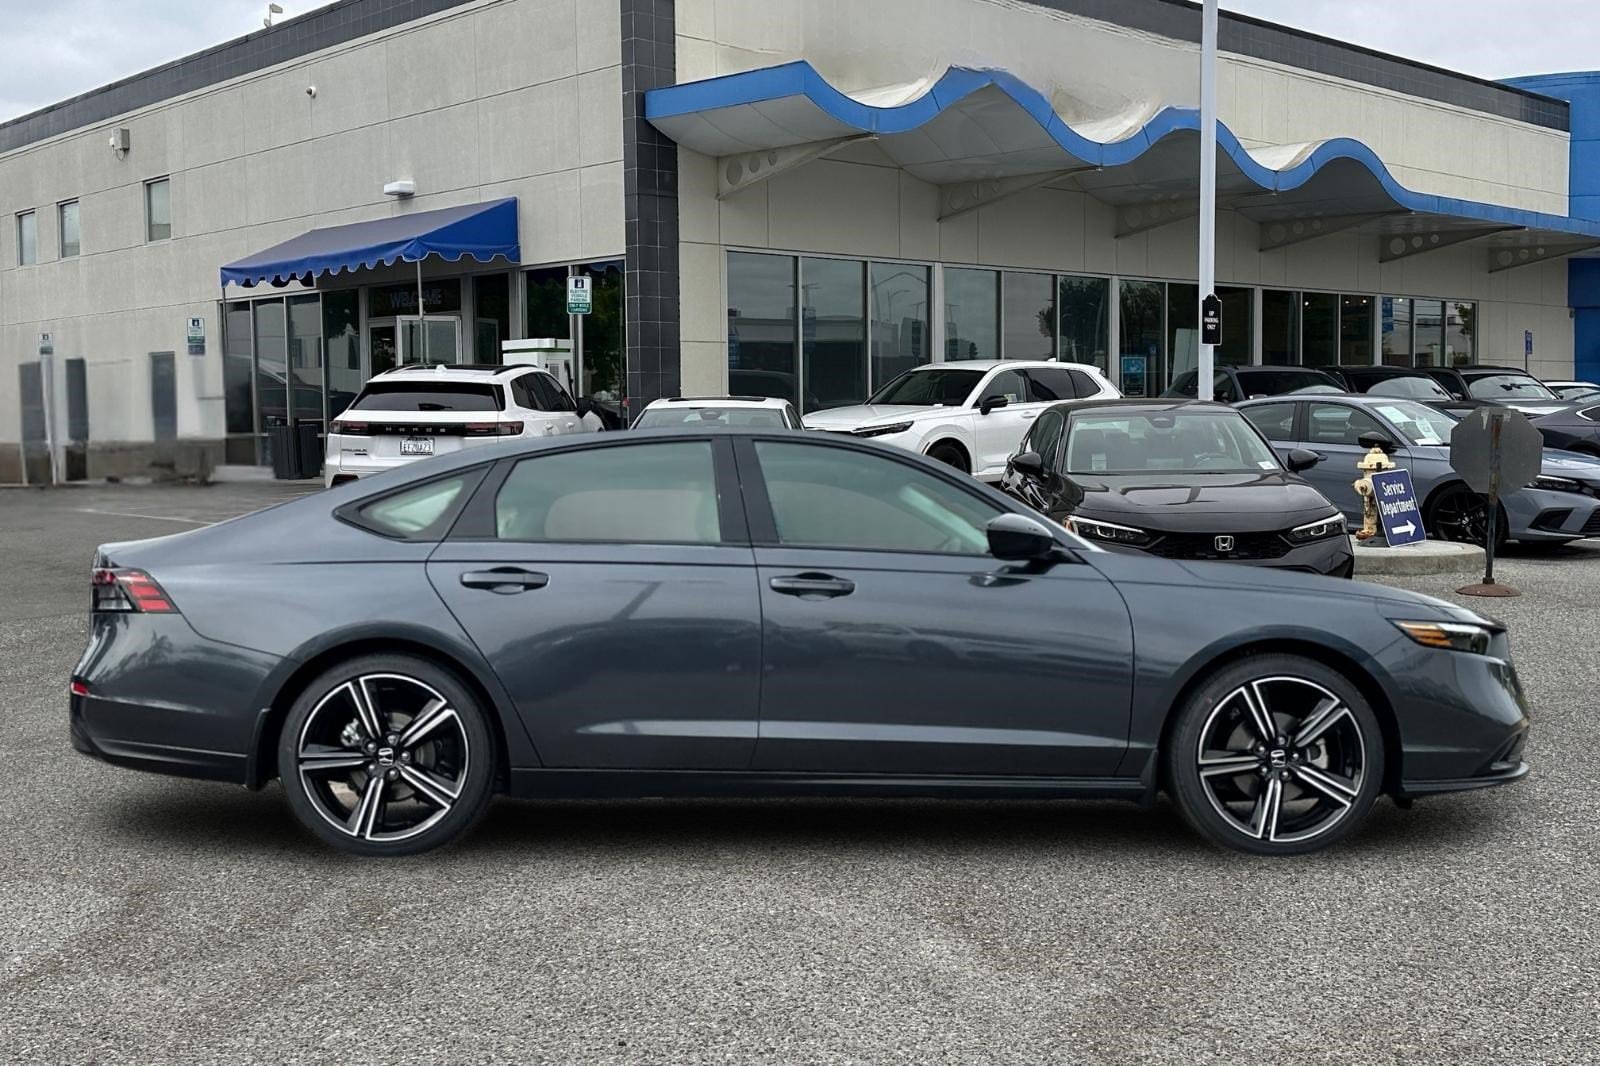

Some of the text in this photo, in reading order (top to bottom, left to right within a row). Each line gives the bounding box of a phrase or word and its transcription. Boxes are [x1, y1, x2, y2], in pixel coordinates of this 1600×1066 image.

[390, 288, 442, 309] WELCME
[1382, 480, 1406, 497] Service
[1380, 496, 1416, 518] Department
